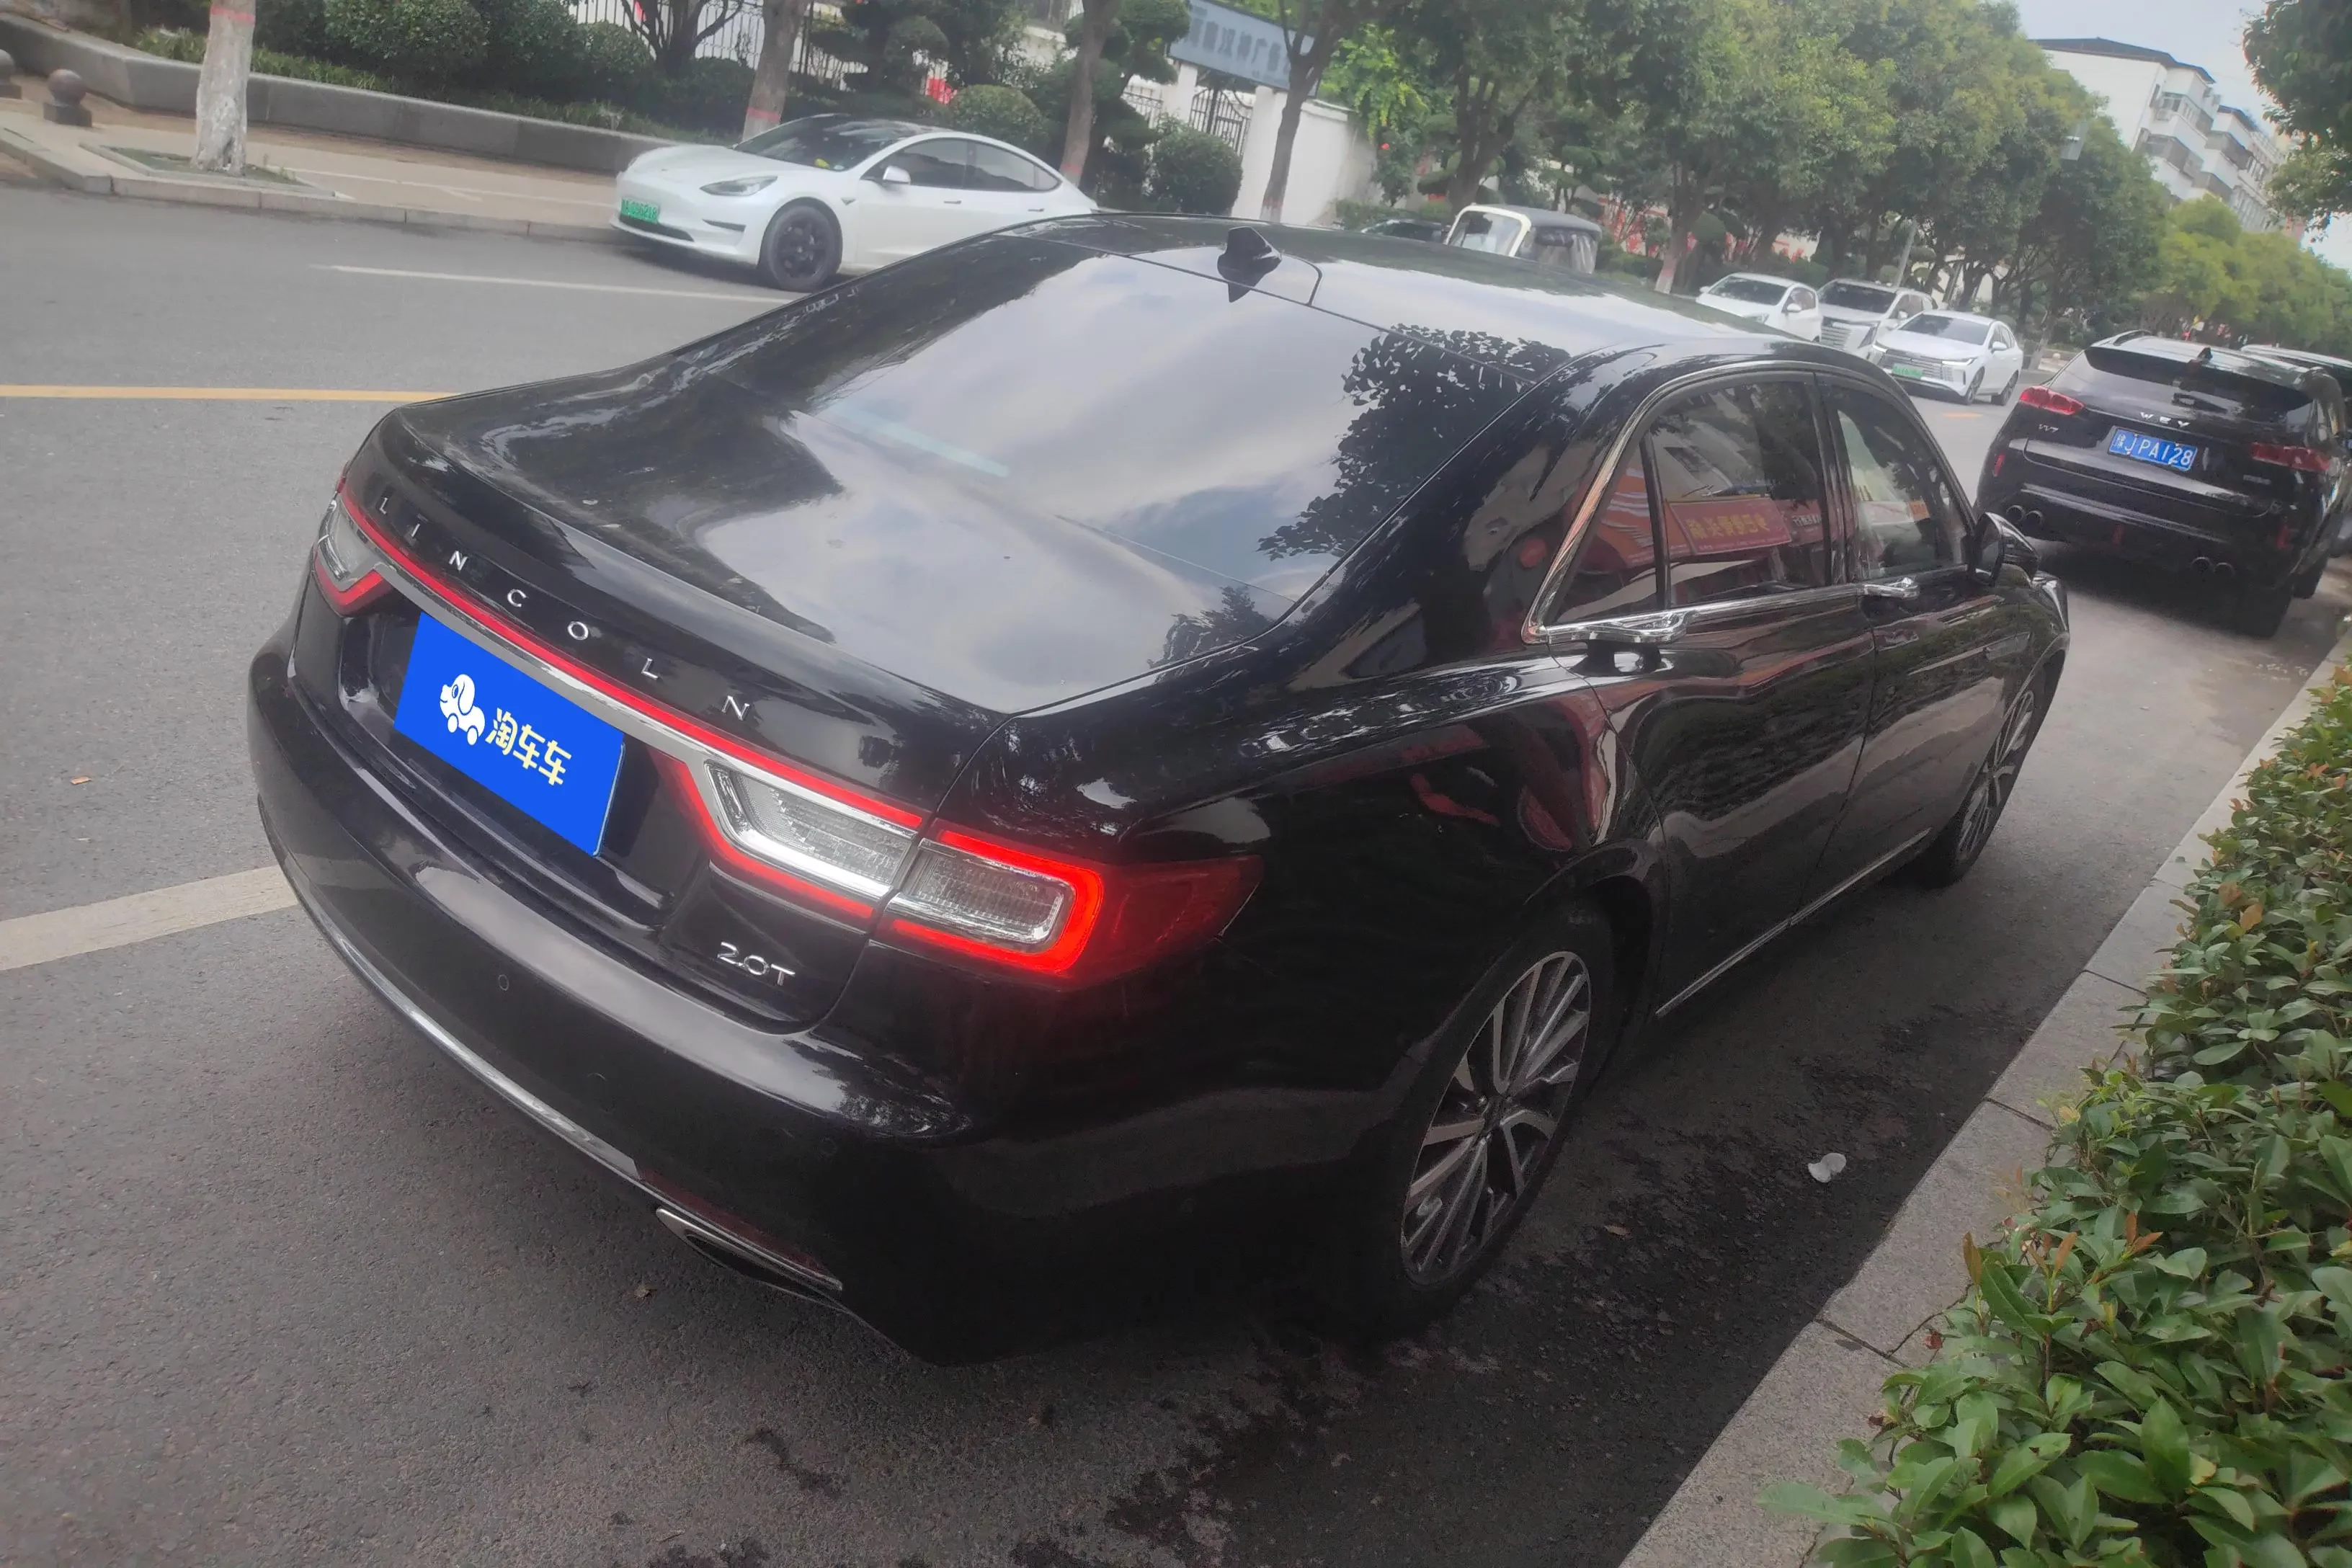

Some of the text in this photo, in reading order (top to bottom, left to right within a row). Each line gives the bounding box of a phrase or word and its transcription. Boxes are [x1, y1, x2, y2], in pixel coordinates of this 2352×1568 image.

[2140, 411, 2191, 427] WEY
[379, 496, 750, 719] LINCOLN
[716, 940, 796, 986] 2.0T
